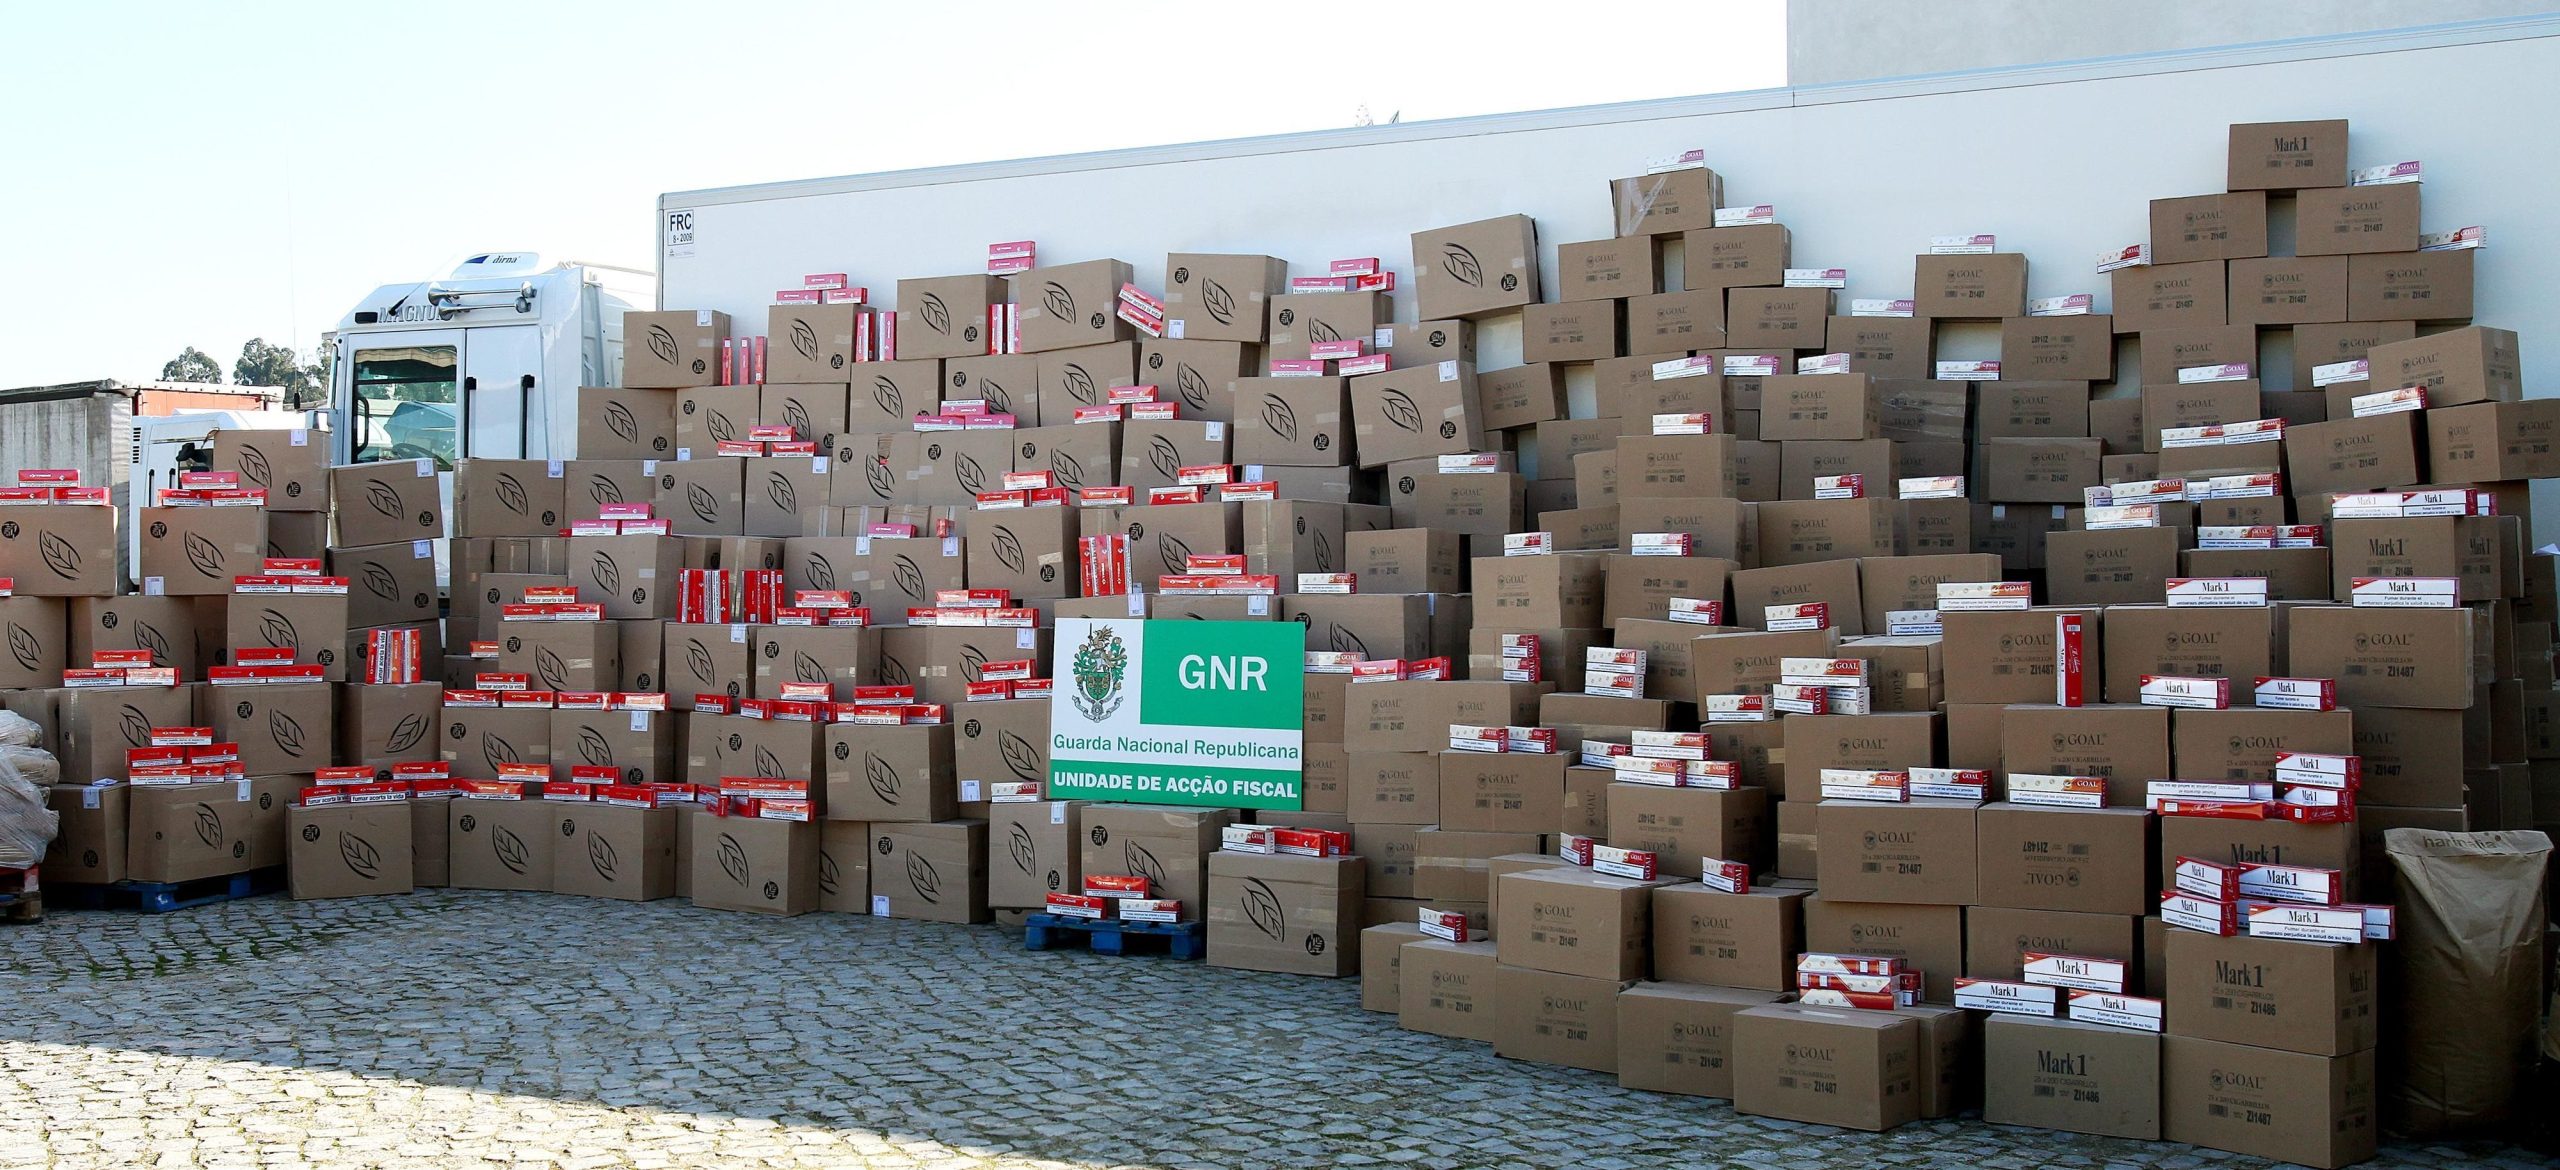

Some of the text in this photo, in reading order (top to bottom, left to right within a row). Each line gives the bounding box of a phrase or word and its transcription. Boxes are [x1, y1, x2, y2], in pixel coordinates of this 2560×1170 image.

[2274, 137, 2308, 152] Mark 1
[2398, 163, 2418, 171] GOAL
[2354, 202, 2380, 211] GOAL
[2197, 211, 2221, 220] GOAL
[670, 213, 691, 231] FRC
[493, 255, 517, 264] dirna
[2275, 274, 2301, 283] GOAL
[2397, 269, 2425, 278] GOAL
[2164, 279, 2190, 288] GOAL
[378, 306, 442, 323] MAGNU
[2184, 343, 2211, 352] GOAL
[2351, 338, 2378, 347] GOAL
[2411, 354, 2438, 365] GOAL
[1801, 391, 1824, 399] GOAL
[2187, 400, 2214, 408] GOAL
[2345, 435, 2372, 446] GOAL
[1656, 453, 1680, 461] GOAL
[1823, 456, 1848, 465] GOAL
[2159, 480, 2181, 488] GOAL
[2425, 494, 2442, 503] Mark 1
[1674, 517, 1700, 525] GOAL
[1801, 519, 1826, 528] GOAL
[2369, 539, 2404, 556] Mark 1
[2096, 550, 2126, 558] GOAL
[1506, 575, 1526, 584] GOAL
[1782, 585, 1810, 594] GOAL
[2203, 582, 2229, 591] Mark 1
[2389, 582, 2416, 591] Mark 1
[2015, 634, 2049, 645] GOAL
[2182, 633, 2217, 644] GOAL
[2371, 634, 2410, 645] GOAL
[1746, 657, 1776, 667] GOAL
[1836, 662, 1859, 670] GOAL
[1178, 654, 1268, 691] GNR
[2031, 665, 2054, 675] ZI1487
[2197, 664, 2222, 674] ZI1487
[2387, 667, 2415, 677] ZI1487
[2165, 681, 2190, 694] Mark 1
[2278, 682, 2295, 693] Mark 1
[1852, 739, 1884, 749] GOAL
[2068, 734, 2104, 745] GOAL
[2245, 736, 2284, 749] GOAL
[1054, 734, 1298, 759] Guarda Nacional Republicana
[1312, 760, 1335, 769] GOAL
[2300, 758, 2319, 769] Mark 1
[1387, 771, 1411, 779] GOAL
[2089, 766, 2112, 776] ZI1487
[2375, 764, 2401, 776] ZI1487
[1489, 774, 1517, 783] GOAL
[1054, 772, 1297, 797] UNIDADE DE ACÇÃO FISCAL
[2302, 790, 2317, 801] Mark 1
[1586, 793, 1595, 816] GOAL
[1879, 832, 1913, 843] GOAL
[2231, 844, 2281, 863] Mark 1
[1899, 864, 1921, 874] ZI1487
[2192, 865, 2205, 877] Mark 1
[2029, 872, 2064, 885] GOAL
[2267, 869, 2298, 886] Mark 1
[1544, 905, 1572, 918] GOAL
[2181, 900, 2198, 913] Mark 1
[2289, 910, 2320, 923] Mark 1
[1703, 919, 1731, 929] GOAL
[1866, 925, 1901, 937] GOAL
[2031, 936, 2069, 950] GOAL
[2056, 960, 2089, 975] Mark 1
[2216, 960, 2264, 987] Mark 1
[1442, 973, 1468, 986] GOAL
[1990, 985, 2017, 997] Mark 1
[1555, 998, 1585, 1012] GOAL
[2101, 997, 2126, 1010] Mark 1
[2251, 1001, 2276, 1016] ZI1486
[1687, 1024, 1720, 1038] GOAL
[1800, 1047, 1832, 1061] GOAL
[1700, 1056, 1723, 1069] ZI1487
[2038, 1050, 2087, 1076] Mark 1
[2226, 1072, 2263, 1089] GOAL
[1814, 1081, 1836, 1094] ZI1487
[2074, 1089, 2099, 1103] ZI1486
[2247, 1110, 2271, 1125] ZI1487
